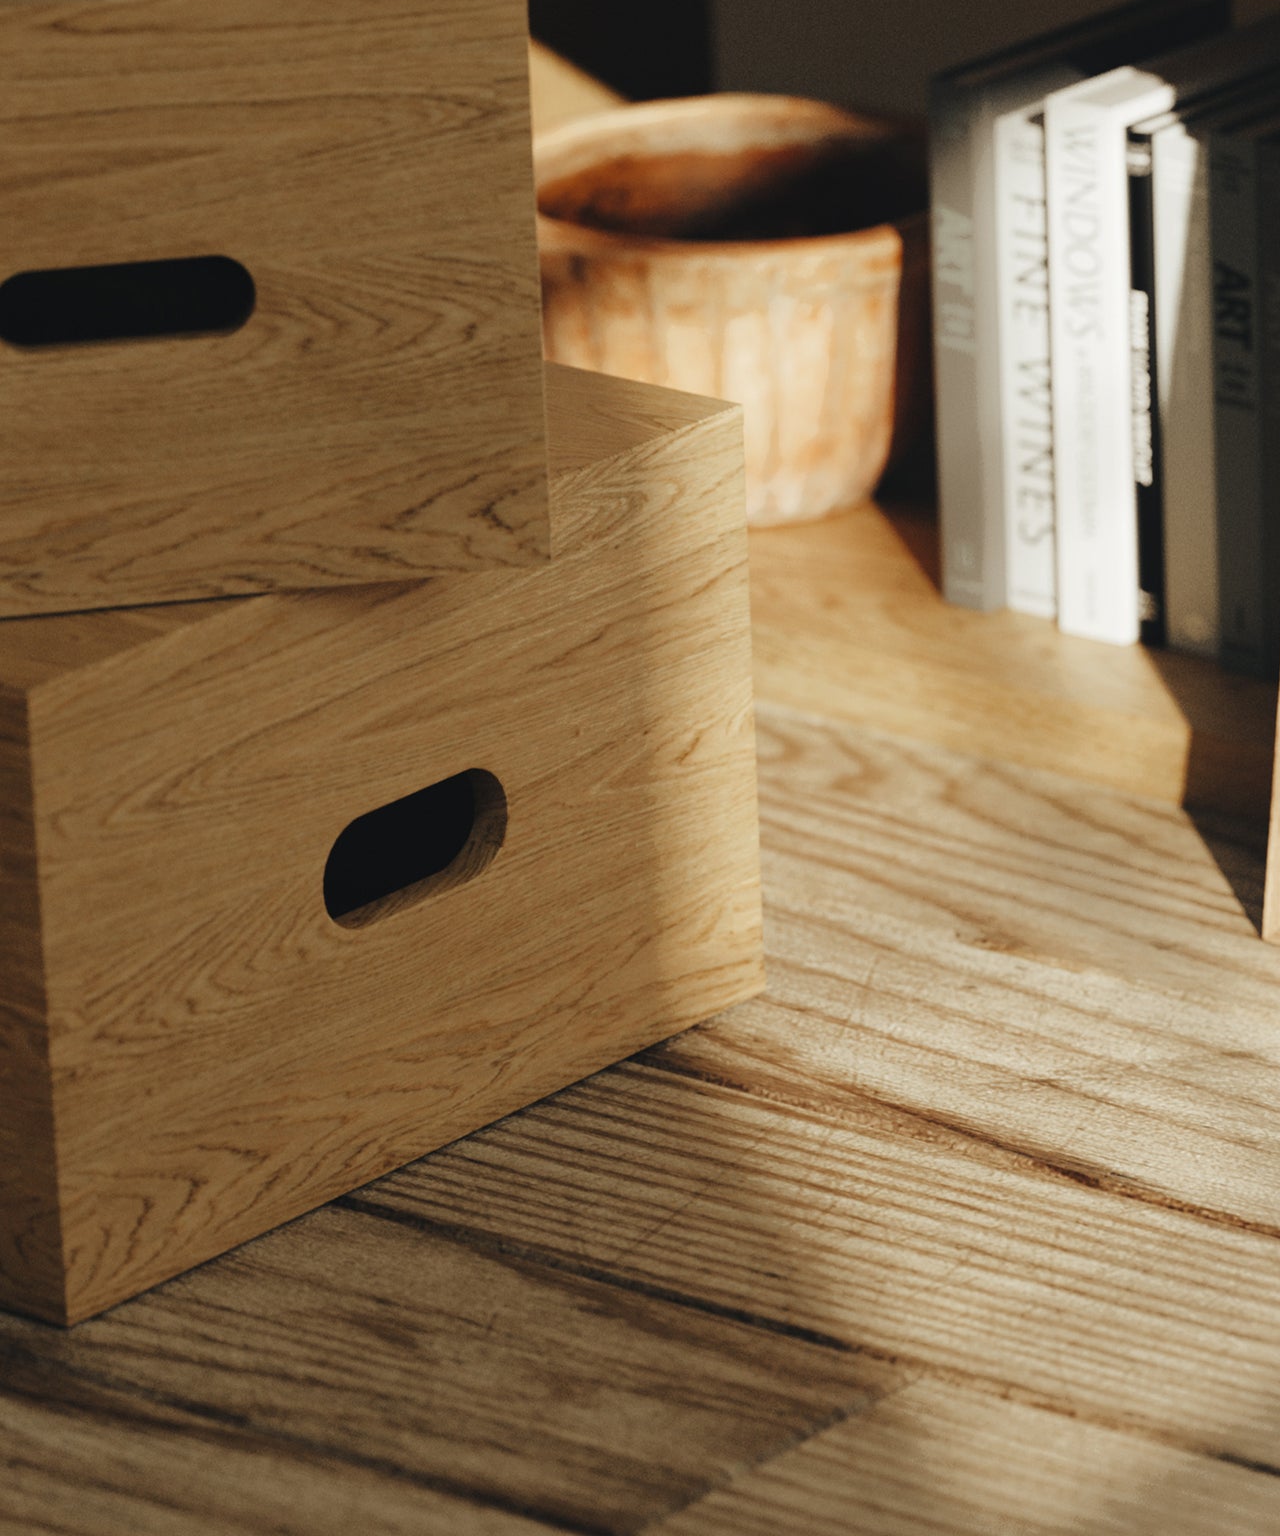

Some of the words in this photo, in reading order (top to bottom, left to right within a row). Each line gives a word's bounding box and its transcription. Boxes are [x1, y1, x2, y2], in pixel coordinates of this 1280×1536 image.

[1009, 189, 1049, 327] FINE
[1060, 120, 1106, 343] WINDOWS
[1014, 353, 1054, 548] WINES
